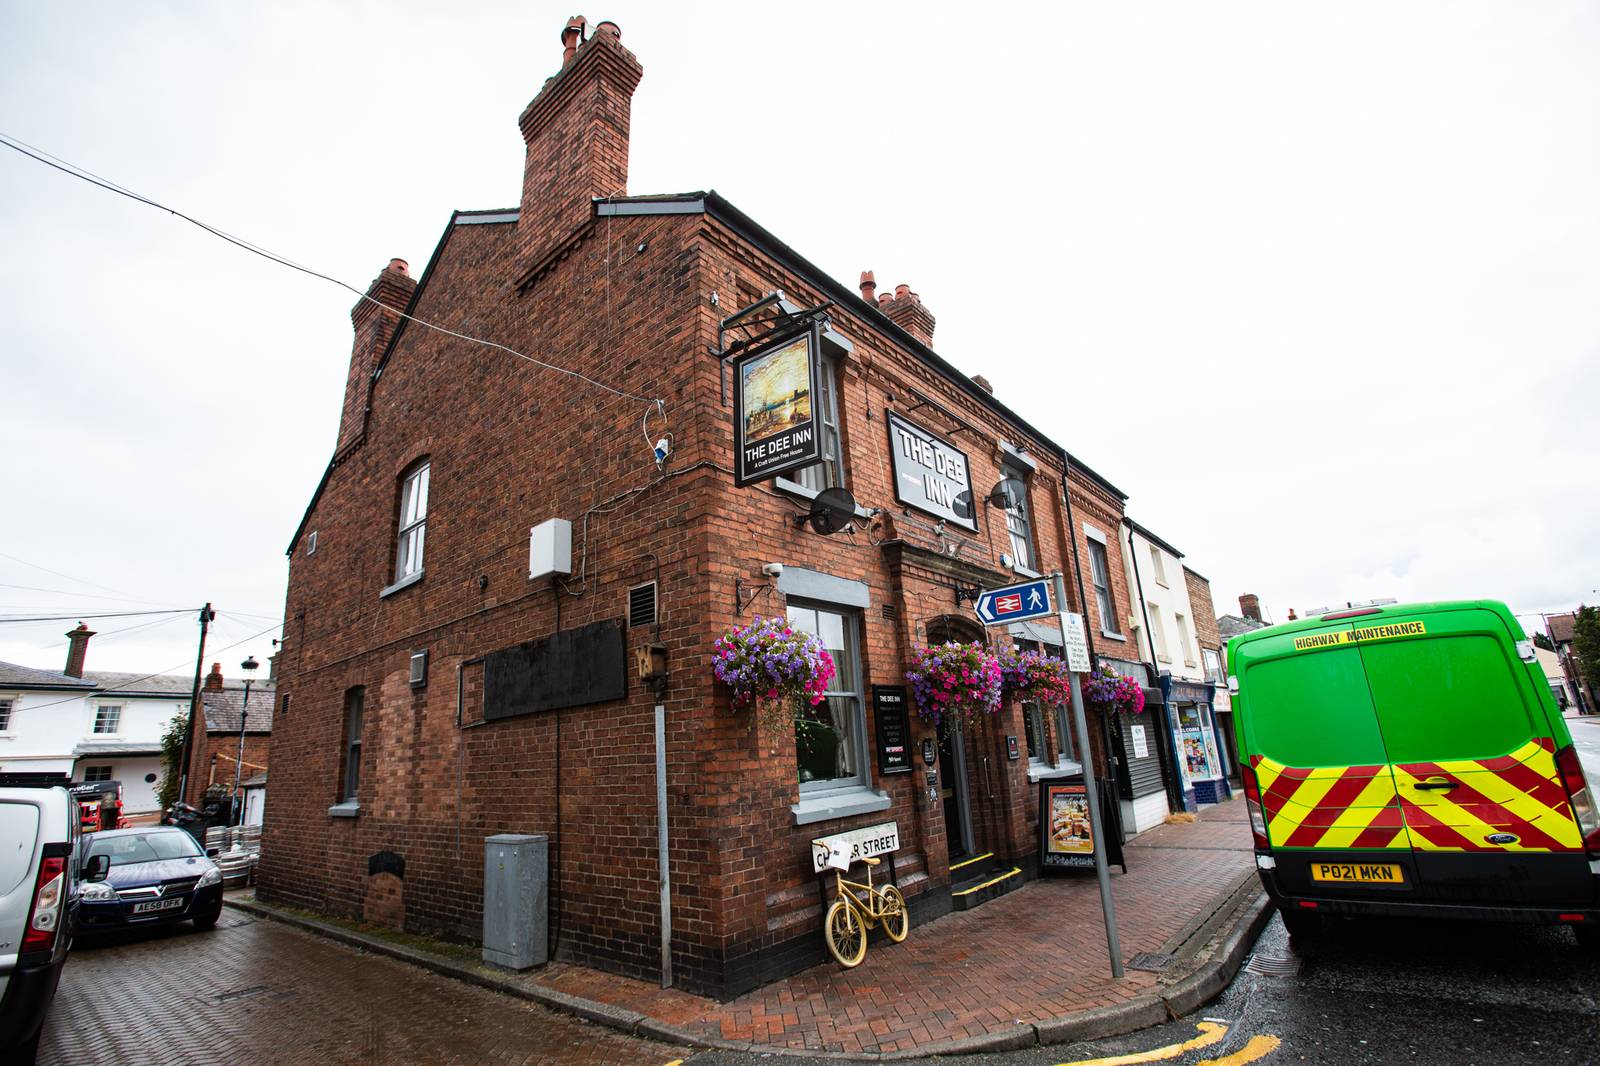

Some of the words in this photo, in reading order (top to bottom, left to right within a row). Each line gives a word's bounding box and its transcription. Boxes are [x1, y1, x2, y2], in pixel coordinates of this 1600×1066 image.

[745, 444, 766, 462] THE
[768, 436, 790, 454] DEE
[793, 428, 812, 446] INN
[768, 455, 780, 464] Union
[780, 452, 790, 460] Free
[789, 447, 803, 456] House
[898, 429, 934, 470] THE
[933, 447, 964, 486] DEE
[923, 473, 951, 509] INN
[1295, 633, 1340, 649] HIGHWAY
[1346, 622, 1423, 642] MAINTENANCE
[862, 834, 896, 855] STREET
[1359, 866, 1393, 880] MKN
